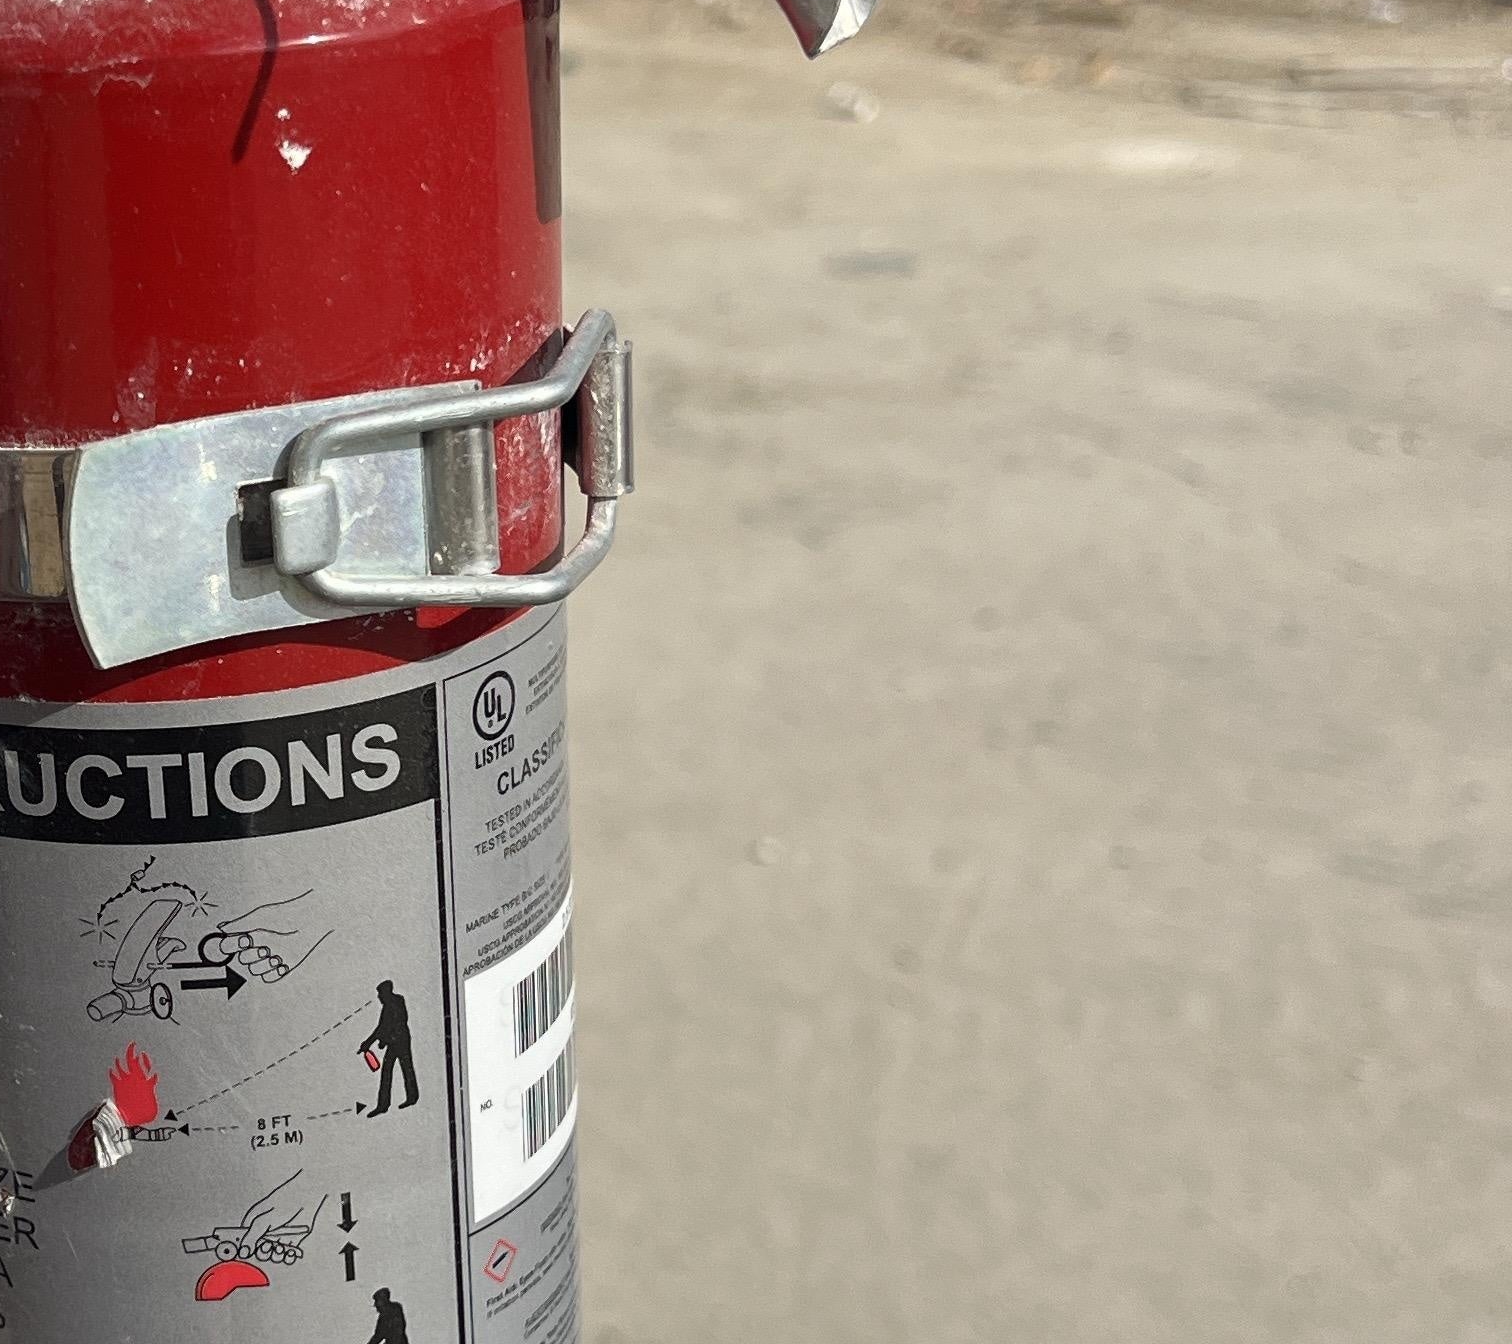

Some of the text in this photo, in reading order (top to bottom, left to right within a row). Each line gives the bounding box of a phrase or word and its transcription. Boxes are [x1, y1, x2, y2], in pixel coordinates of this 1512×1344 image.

[475, 734, 515, 769] LISTED
[485, 804, 522, 833] TESTED
[256, 1114, 292, 1132] 8 FT
[250, 1129, 304, 1149] (2.5 M)
